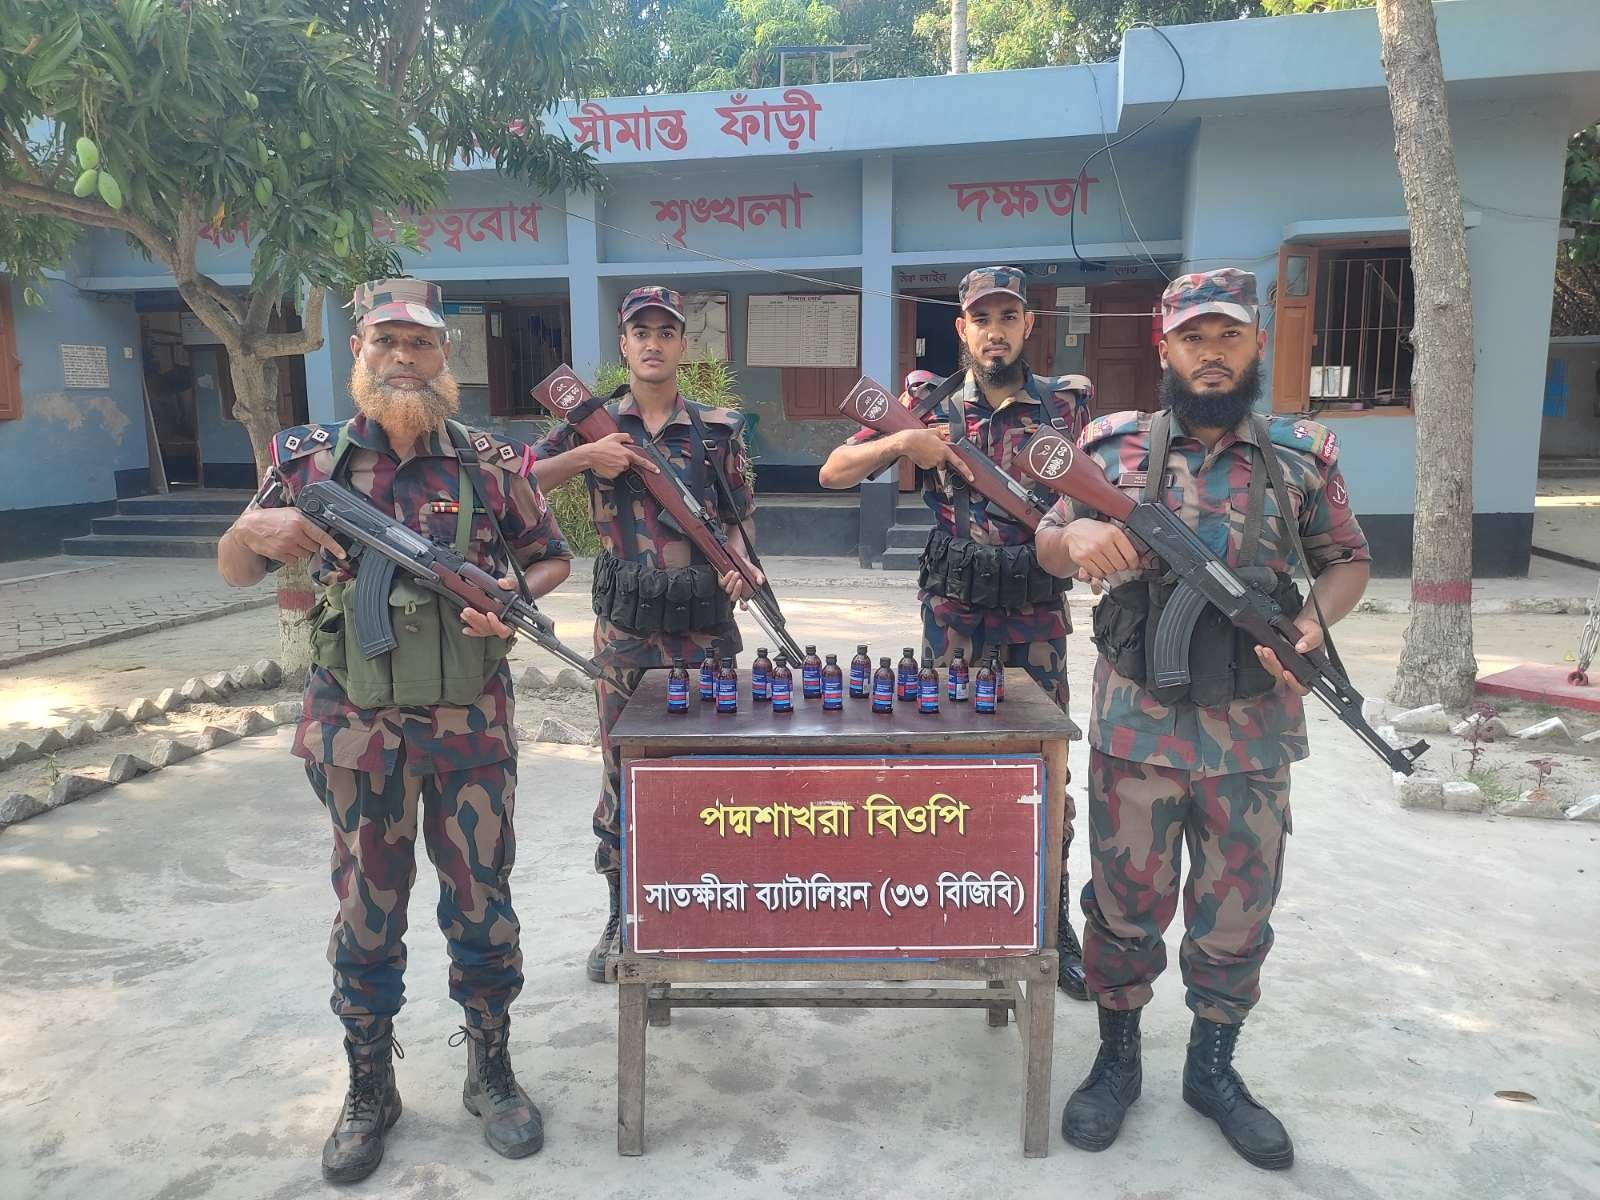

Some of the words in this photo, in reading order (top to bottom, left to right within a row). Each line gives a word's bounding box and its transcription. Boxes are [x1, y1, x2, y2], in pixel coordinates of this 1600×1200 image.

[569, 103, 688, 153] সীমান্ত
[715, 88, 822, 151] ফাঁড়ী
[650, 180, 814, 248] শৃঙ্খলা
[947, 167, 1100, 223] দক্ষতা
[700, 801, 855, 838] পদ্মশাখরা
[863, 793, 971, 837] বিওপি
[643, 873, 749, 912] সাতক্ষীরা
[753, 873, 873, 912] ব্যাটালিয়ন
[879, 877, 929, 917] (৩৩
[937, 871, 1025, 916] বিজিবি)
